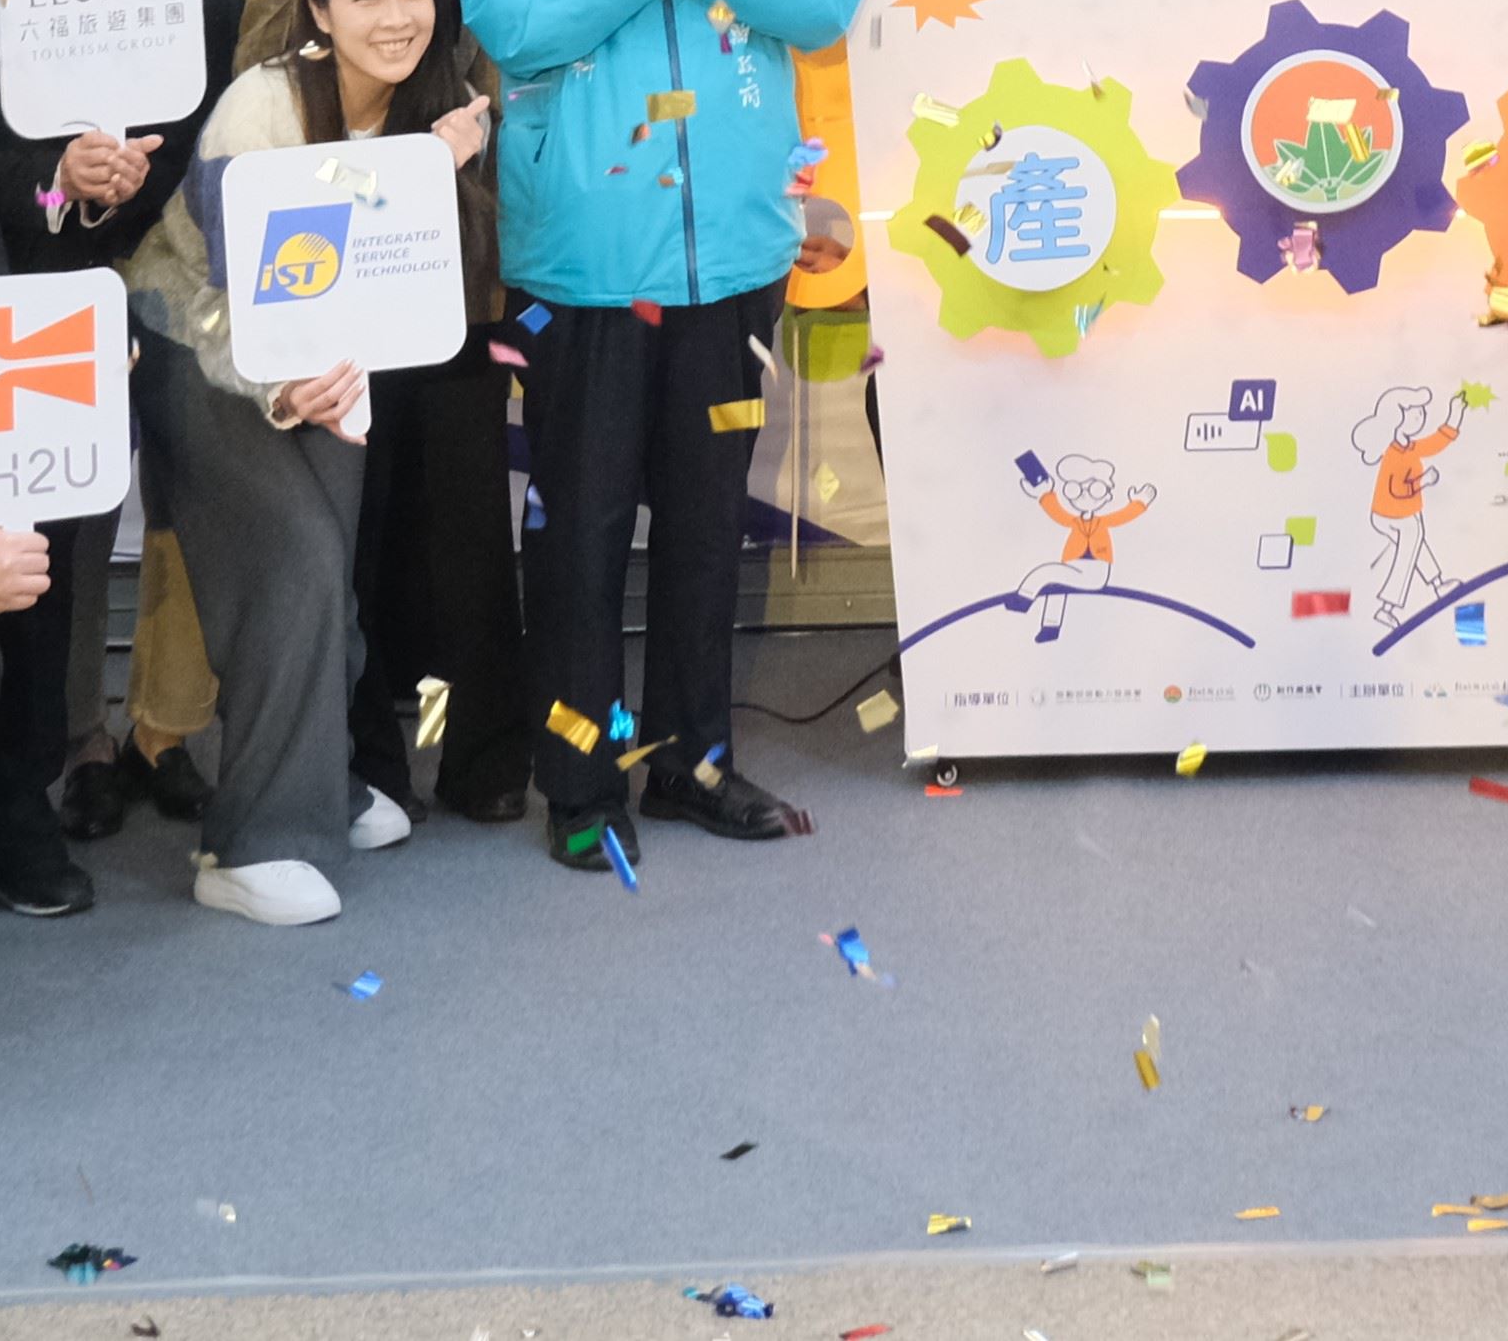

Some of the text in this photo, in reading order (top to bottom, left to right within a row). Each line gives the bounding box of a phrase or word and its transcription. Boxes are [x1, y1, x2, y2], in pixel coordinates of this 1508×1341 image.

[19, 2, 187, 44] 六福旅遊集團
[31, 33, 179, 63] TOURISM GROUP
[983, 153, 1092, 265] 產
[351, 229, 441, 249] INTEGRATED
[353, 246, 411, 265] SERVICE
[355, 258, 451, 279] TECHNOLOGY
[1239, 388, 1264, 412] AI
